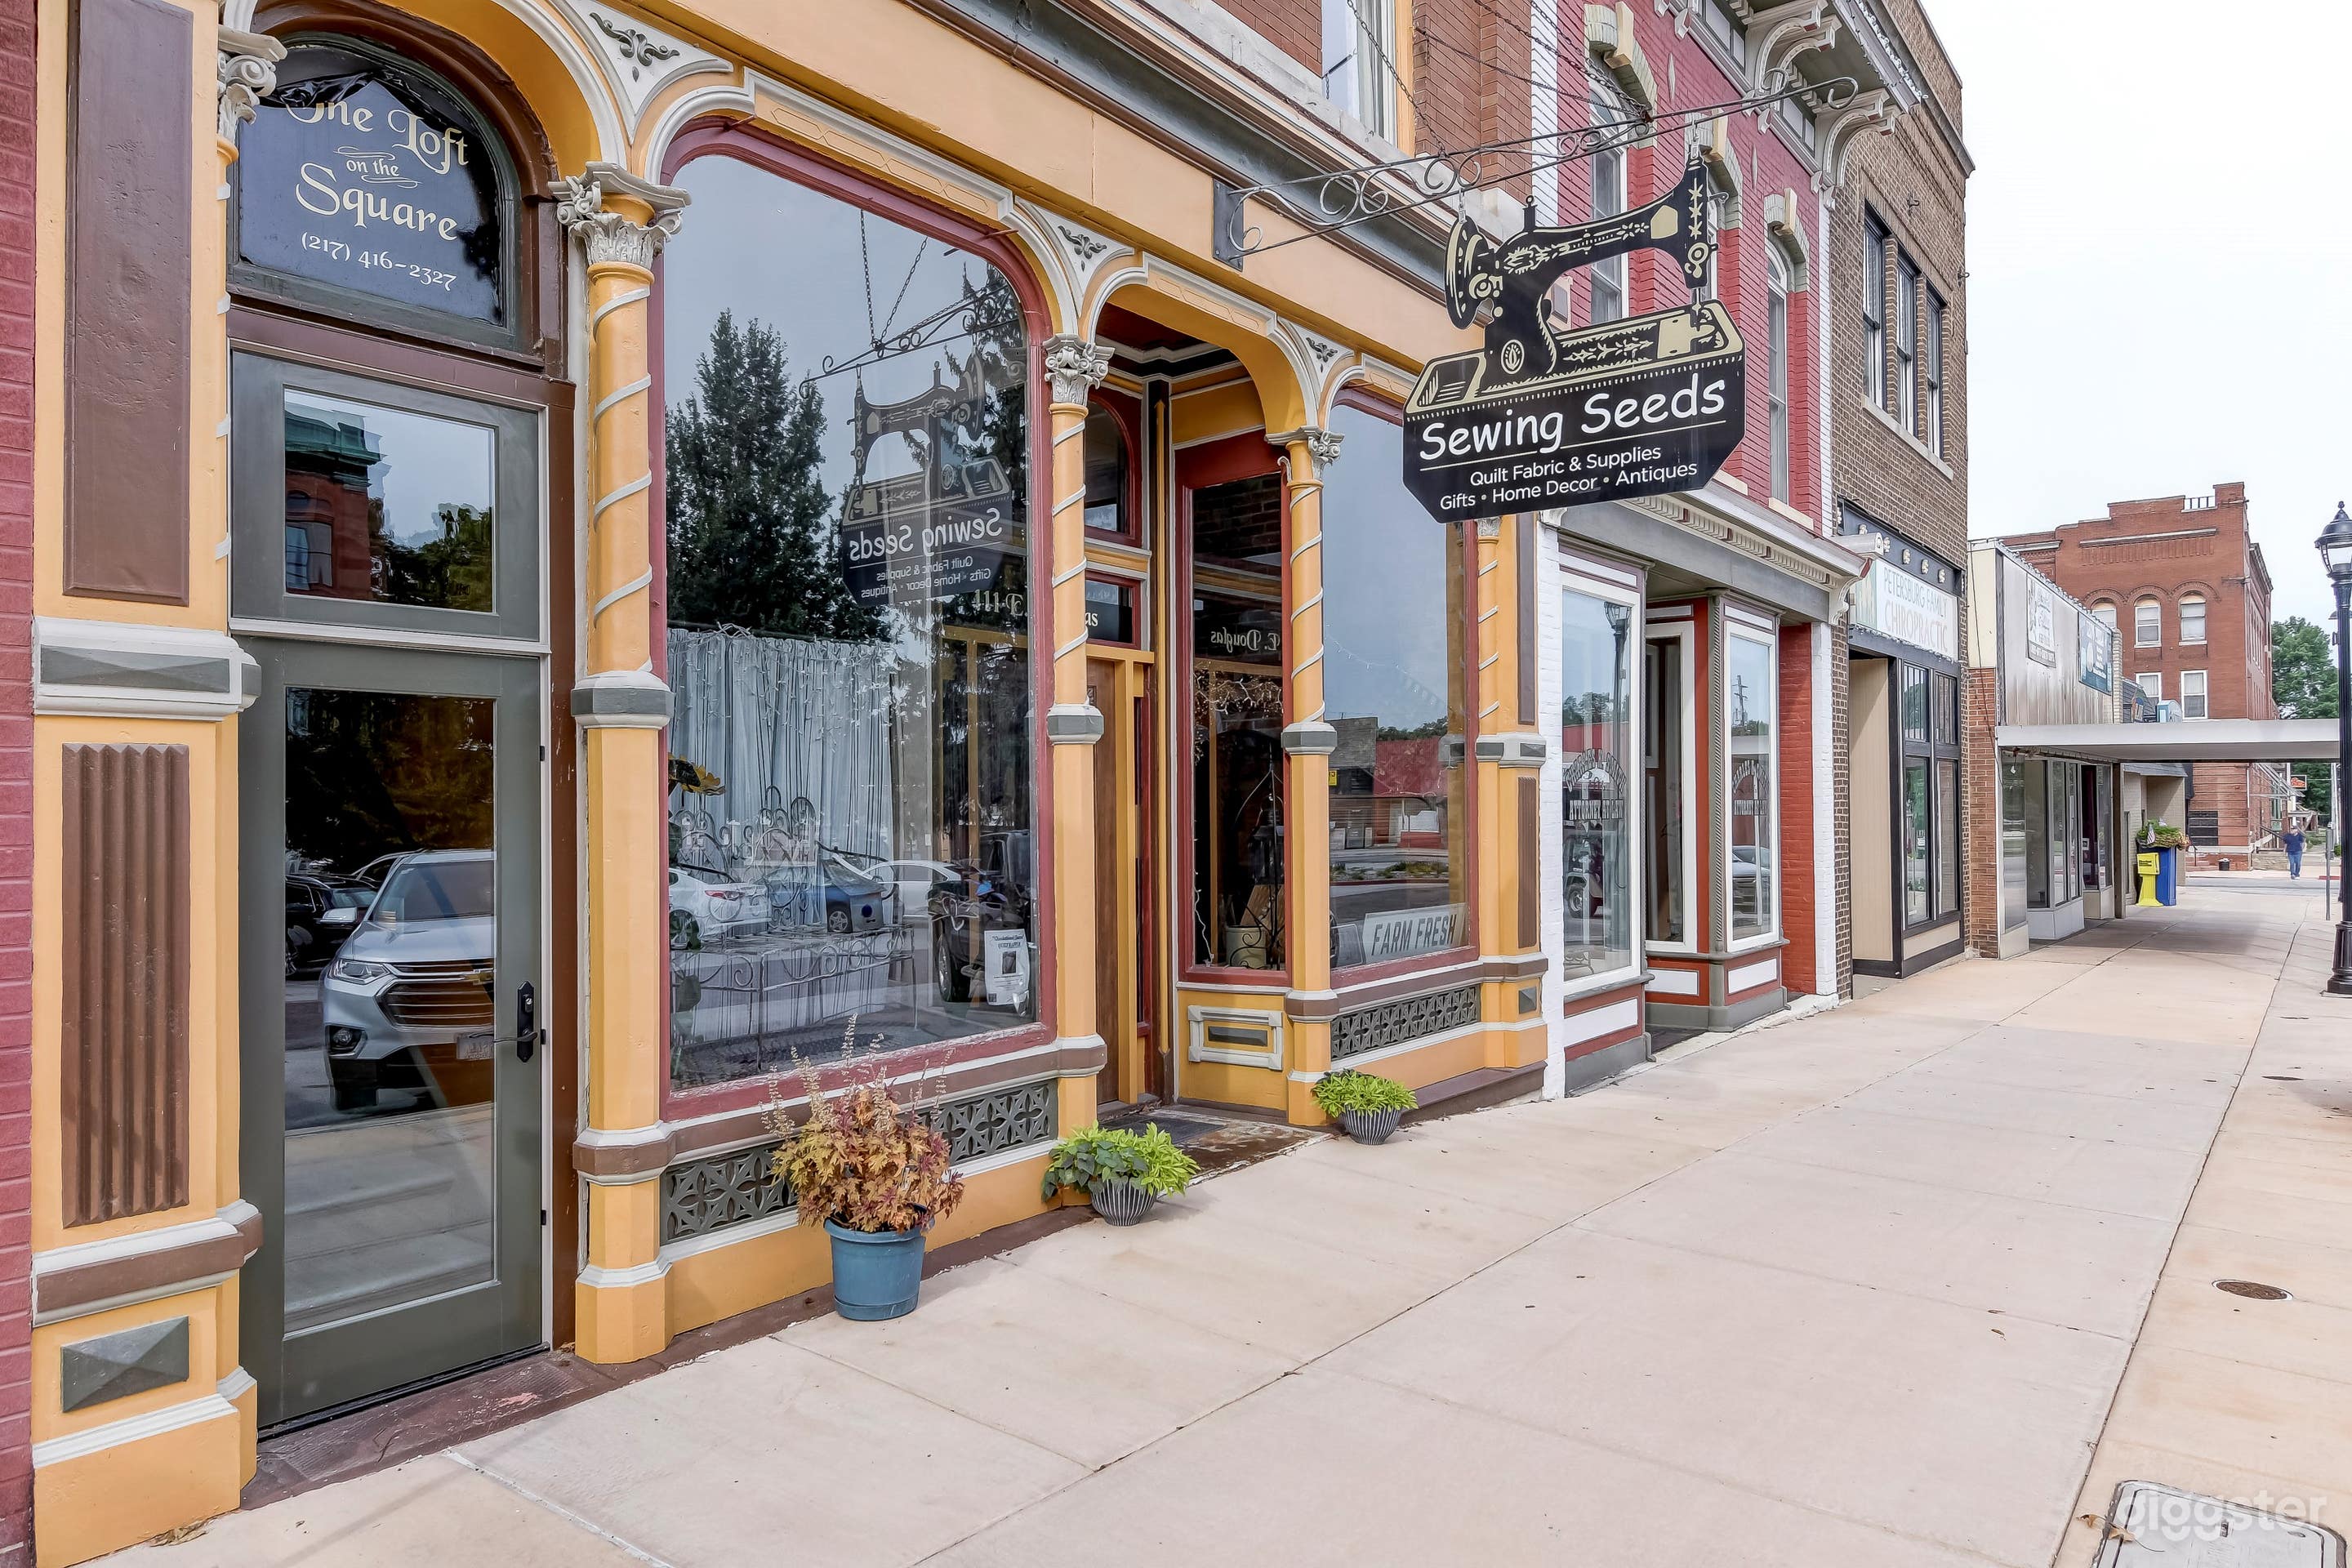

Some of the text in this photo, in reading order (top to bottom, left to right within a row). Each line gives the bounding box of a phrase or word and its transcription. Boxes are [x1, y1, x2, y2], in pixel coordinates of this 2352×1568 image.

[346, 158, 399, 176] on the
[388, 109, 469, 175] Loft
[296, 163, 457, 240] Square
[301, 232, 457, 291] (217) 416-2327
[1419, 372, 1726, 461] Sewing Seeds
[1440, 463, 1698, 510] Gifts Home Decor Antiques
[1470, 447, 1661, 486] Quilt Fabric & Supplies
[1883, 566, 1948, 618] PETERSBURG FAMILY
[1884, 599, 1948, 653] CHIROPRACTIC
[1371, 914, 1457, 956] FARM FRESH
